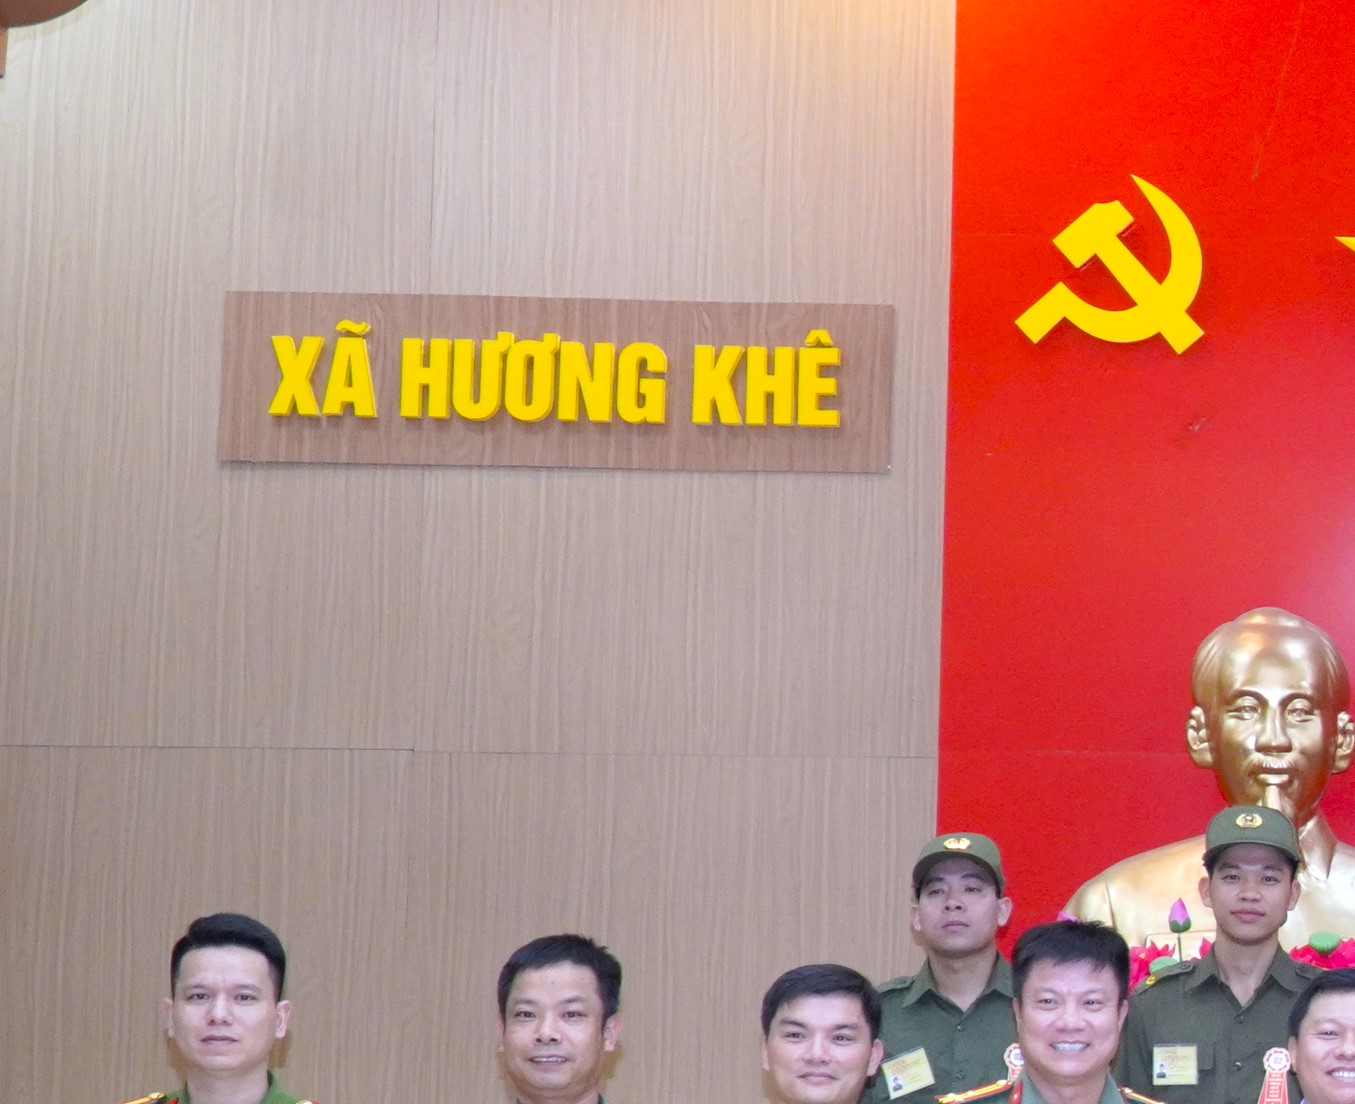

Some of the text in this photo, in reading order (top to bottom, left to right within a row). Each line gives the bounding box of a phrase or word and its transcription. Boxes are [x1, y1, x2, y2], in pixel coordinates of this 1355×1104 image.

[268, 319, 840, 427] XÃ HƯƠNG KHÊ
